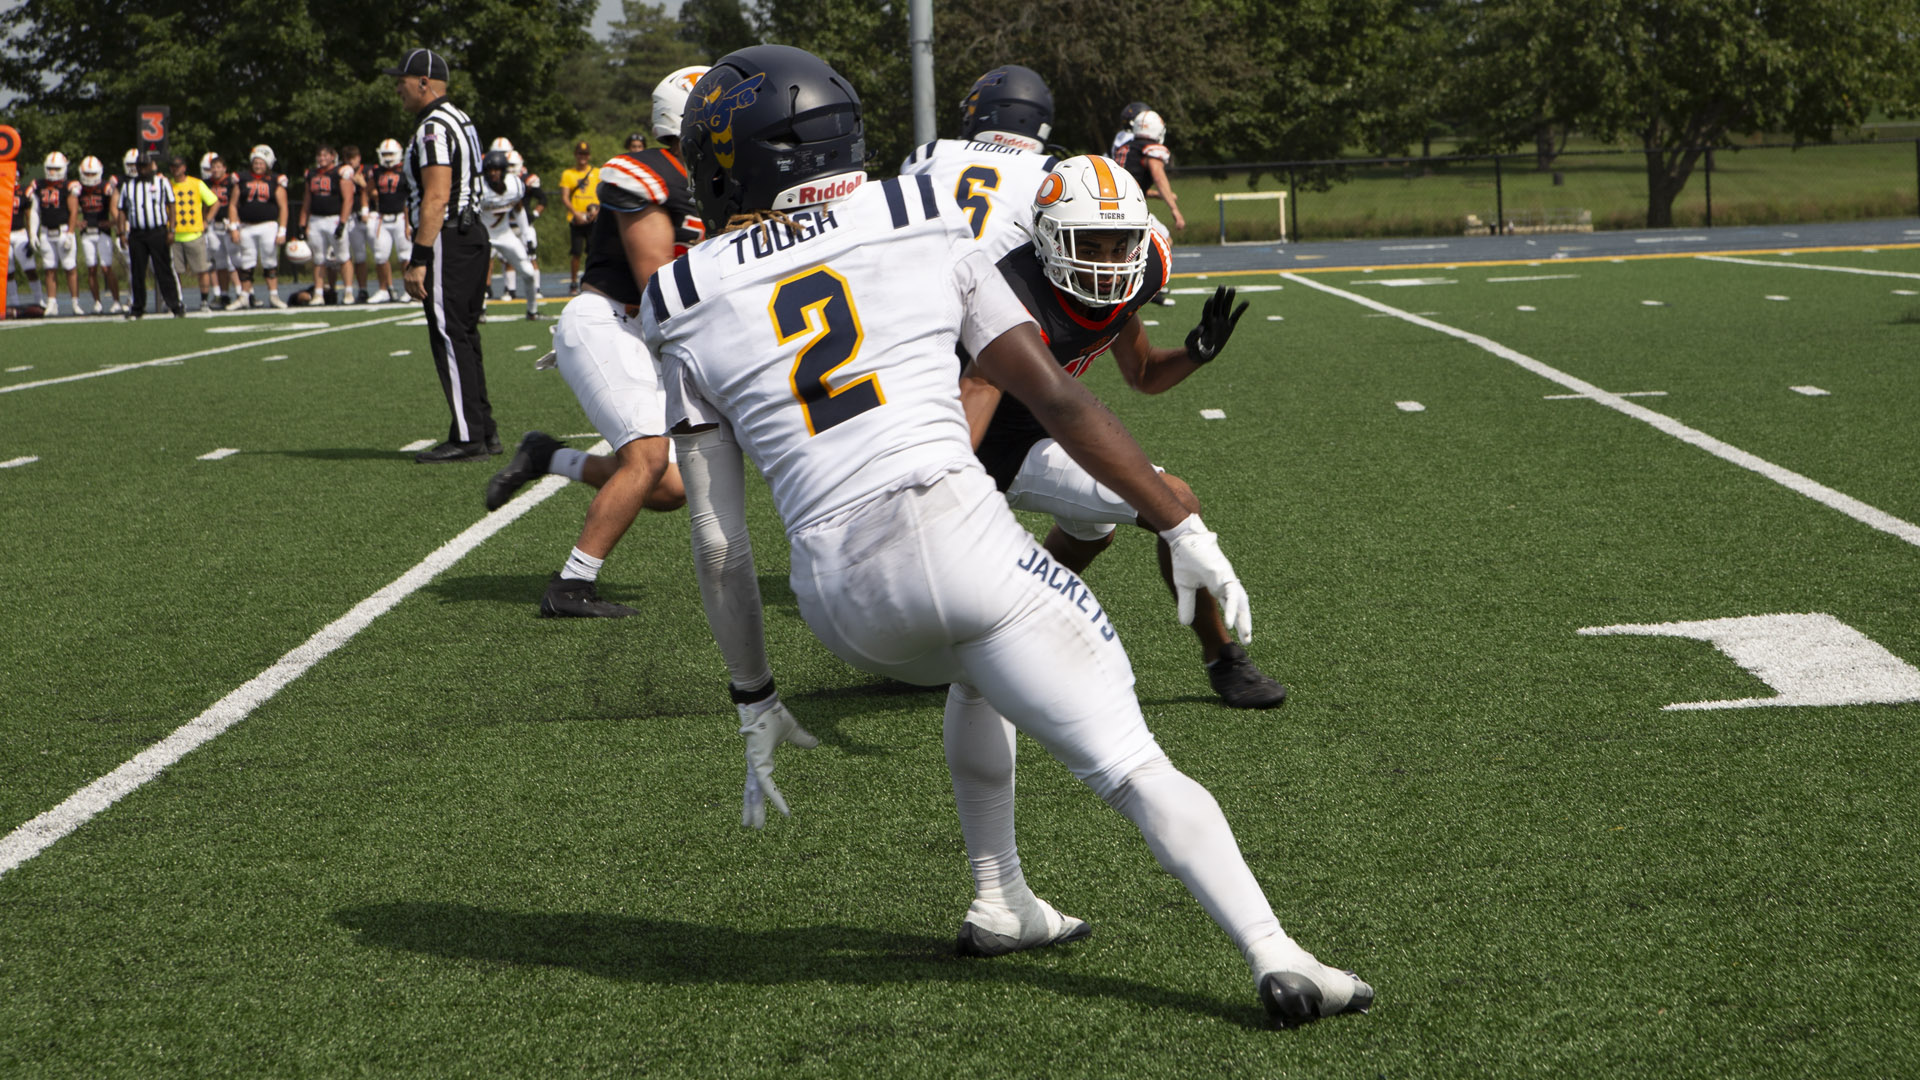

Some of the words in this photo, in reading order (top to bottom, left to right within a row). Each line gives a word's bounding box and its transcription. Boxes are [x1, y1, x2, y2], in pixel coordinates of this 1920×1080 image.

[141, 111, 164, 141] 3
[799, 174, 862, 204] Riddell
[955, 164, 1002, 241] 6
[729, 209, 839, 265] TOUGH
[1099, 212, 1125, 220] TIGERS
[767, 264, 887, 437] 2
